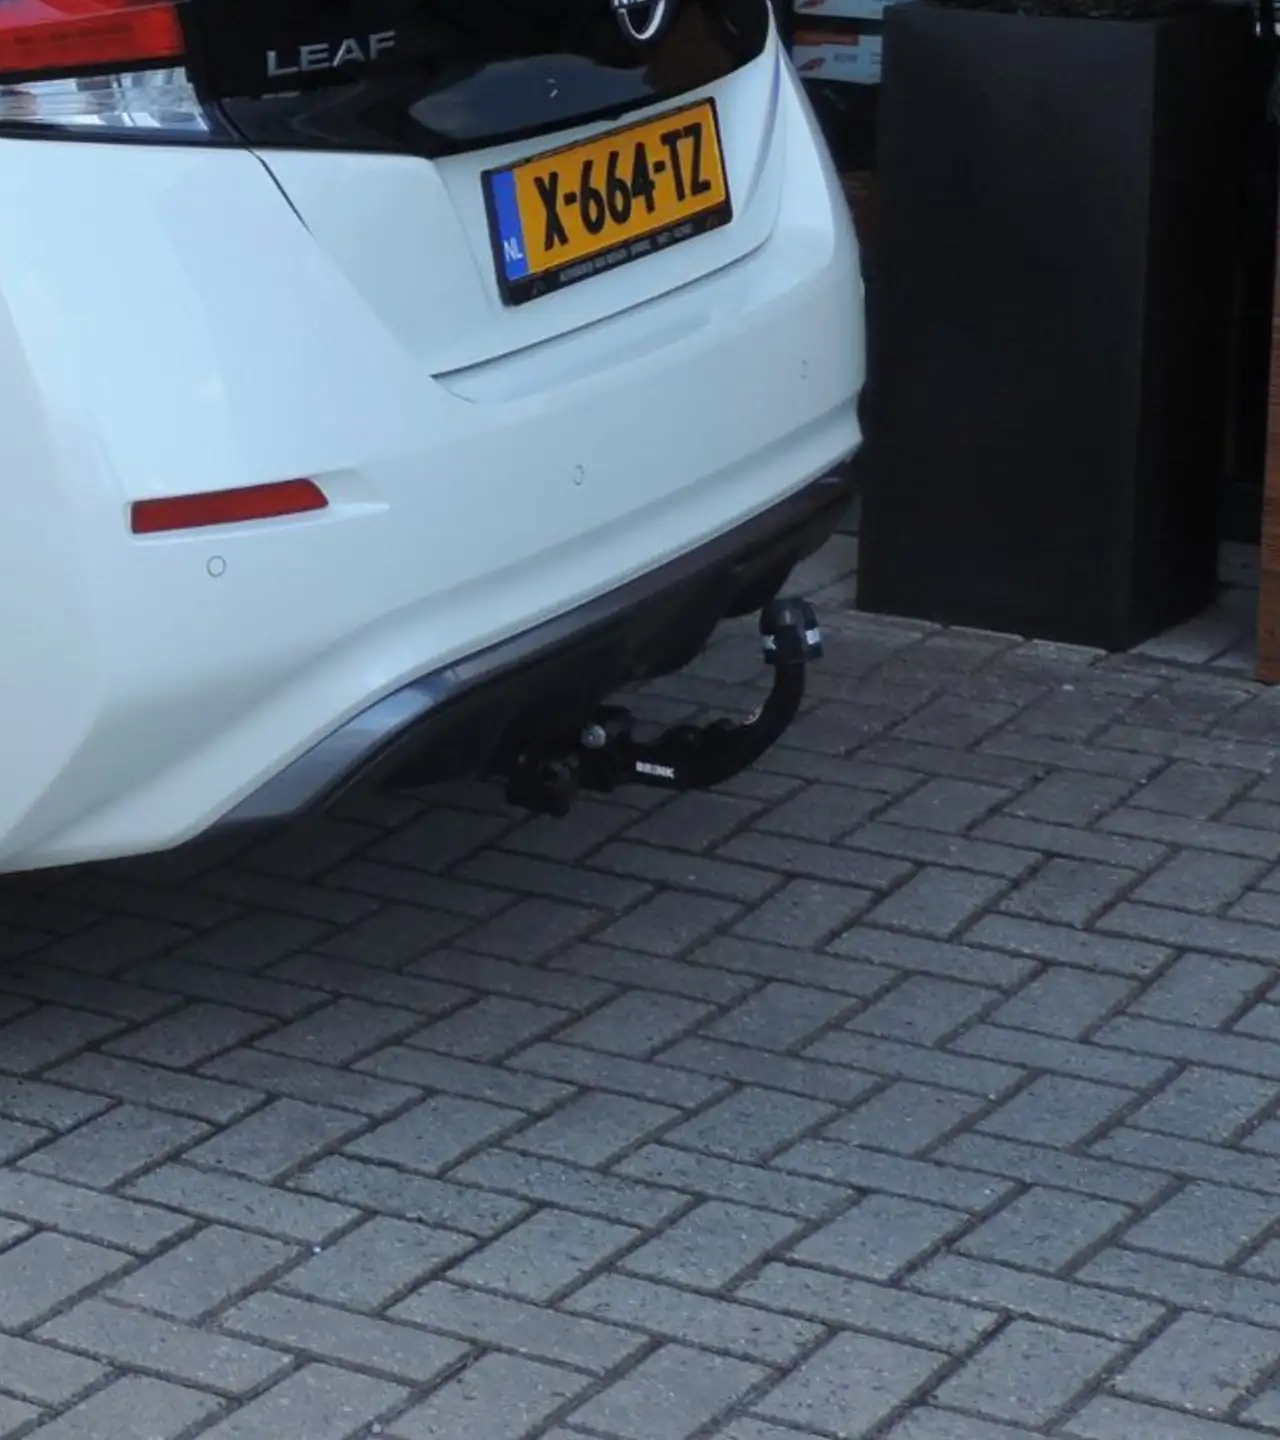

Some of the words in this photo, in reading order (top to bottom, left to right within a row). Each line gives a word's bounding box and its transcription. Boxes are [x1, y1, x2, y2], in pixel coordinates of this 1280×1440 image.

[265, 29, 397, 78] LEAF
[533, 121, 713, 252] X-664-TZ
[503, 235, 524, 262] NL
